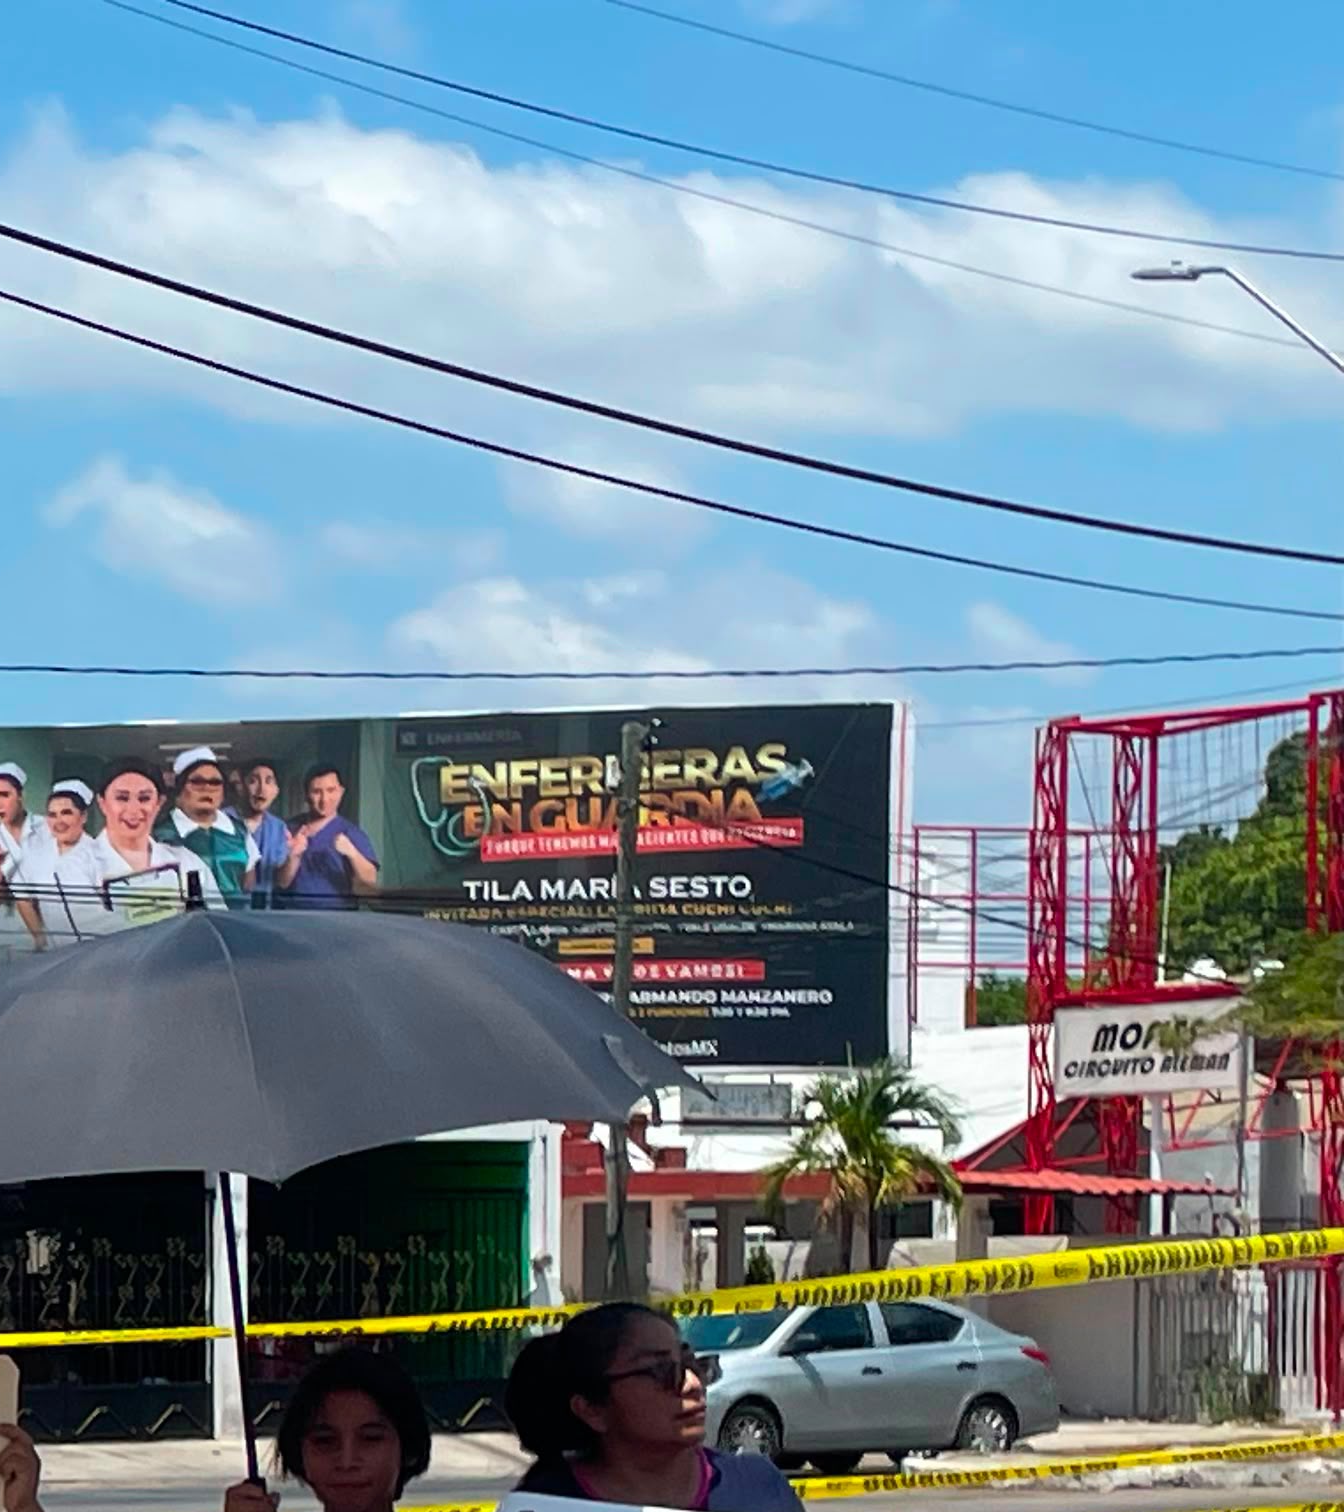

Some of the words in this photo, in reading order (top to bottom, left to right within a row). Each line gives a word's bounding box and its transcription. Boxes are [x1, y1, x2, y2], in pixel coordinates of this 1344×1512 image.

[463, 802, 523, 837] EN
[463, 879, 534, 902] TILA
[649, 875, 752, 900] SESTO
[628, 990, 718, 1004] ARMANDO
[720, 990, 834, 1004] MANZANERO
[1063, 1057, 1156, 1078] CIRCUITO
